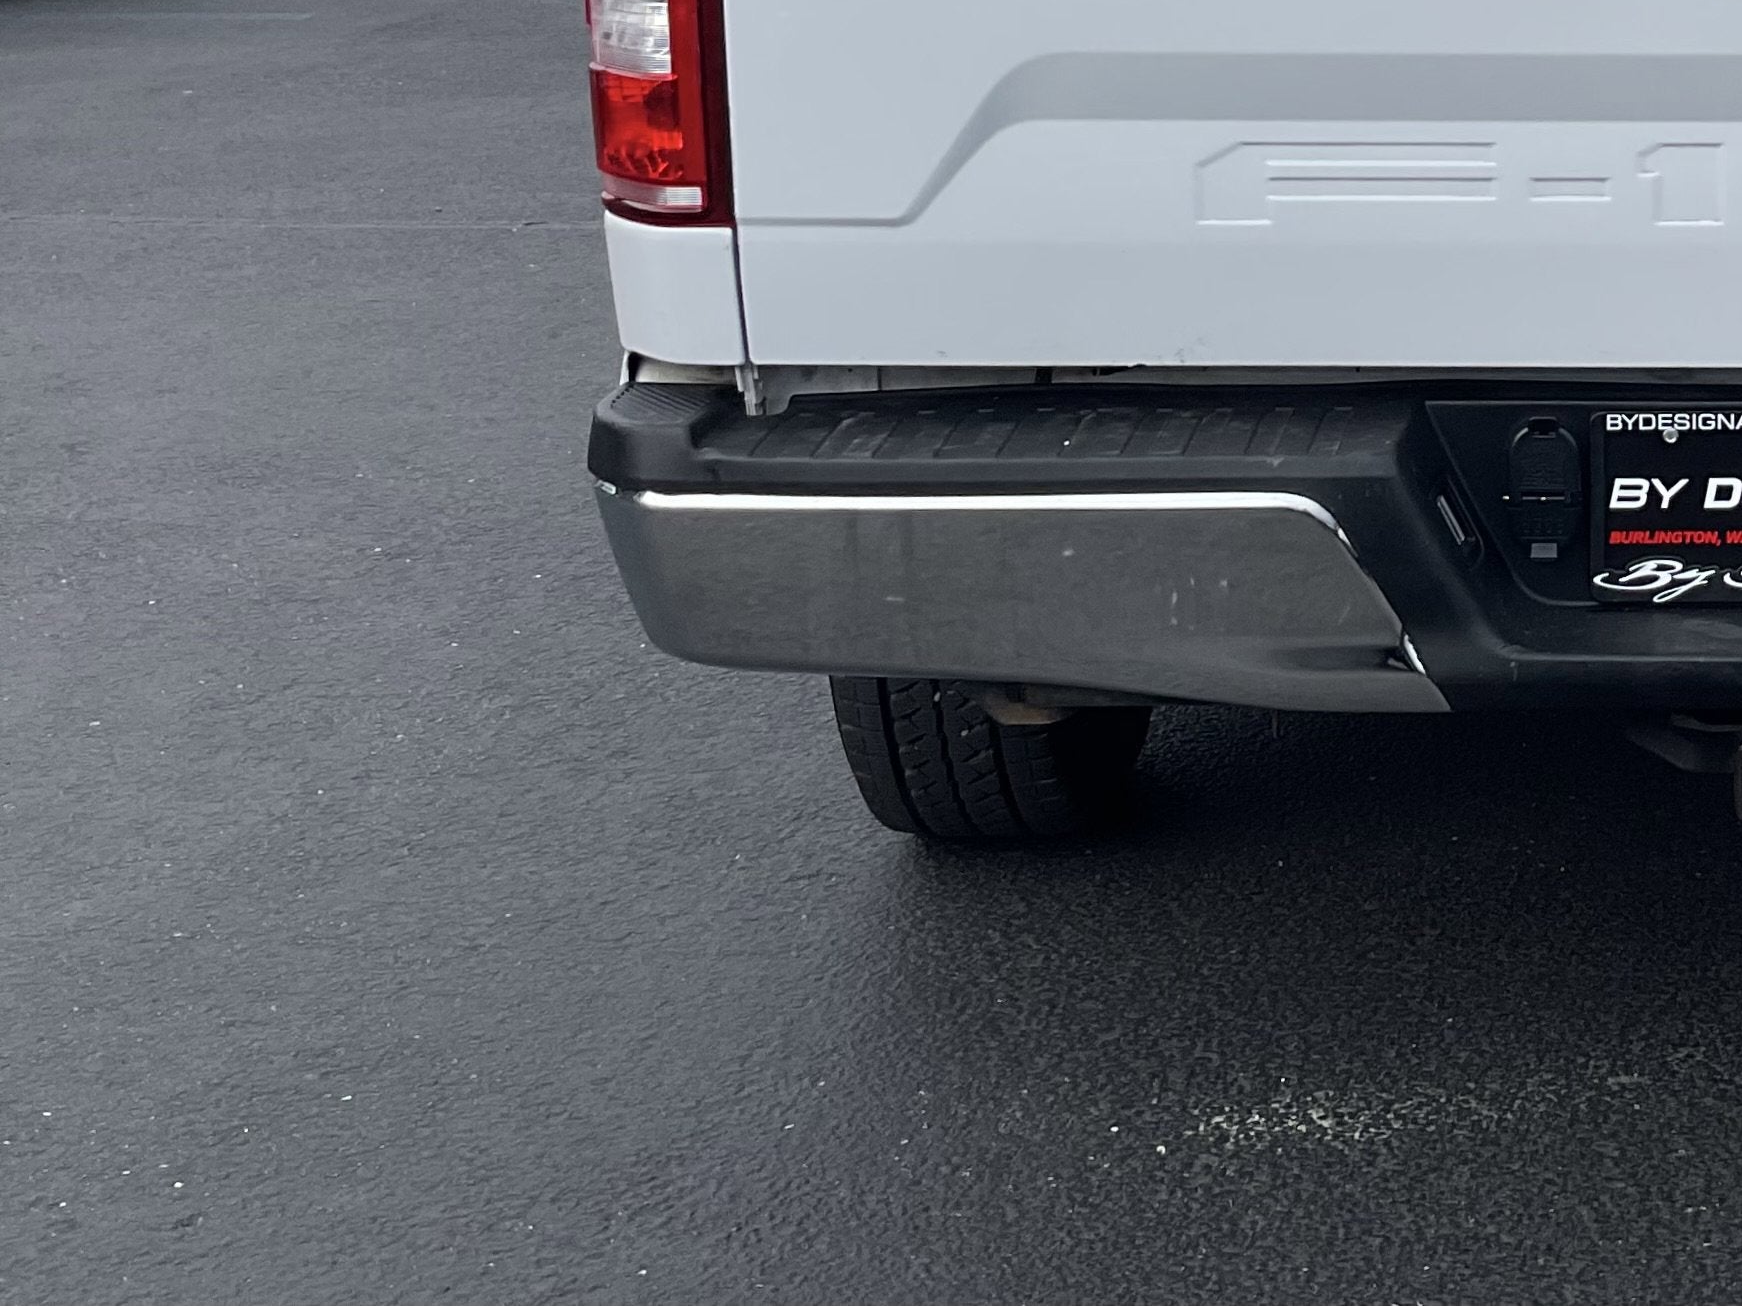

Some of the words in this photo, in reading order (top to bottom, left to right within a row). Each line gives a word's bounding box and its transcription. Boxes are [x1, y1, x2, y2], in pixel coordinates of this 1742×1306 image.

[1609, 477, 1689, 509] BY
[1608, 530, 1721, 547] BURLINGTON,
[1593, 559, 1715, 603] By
